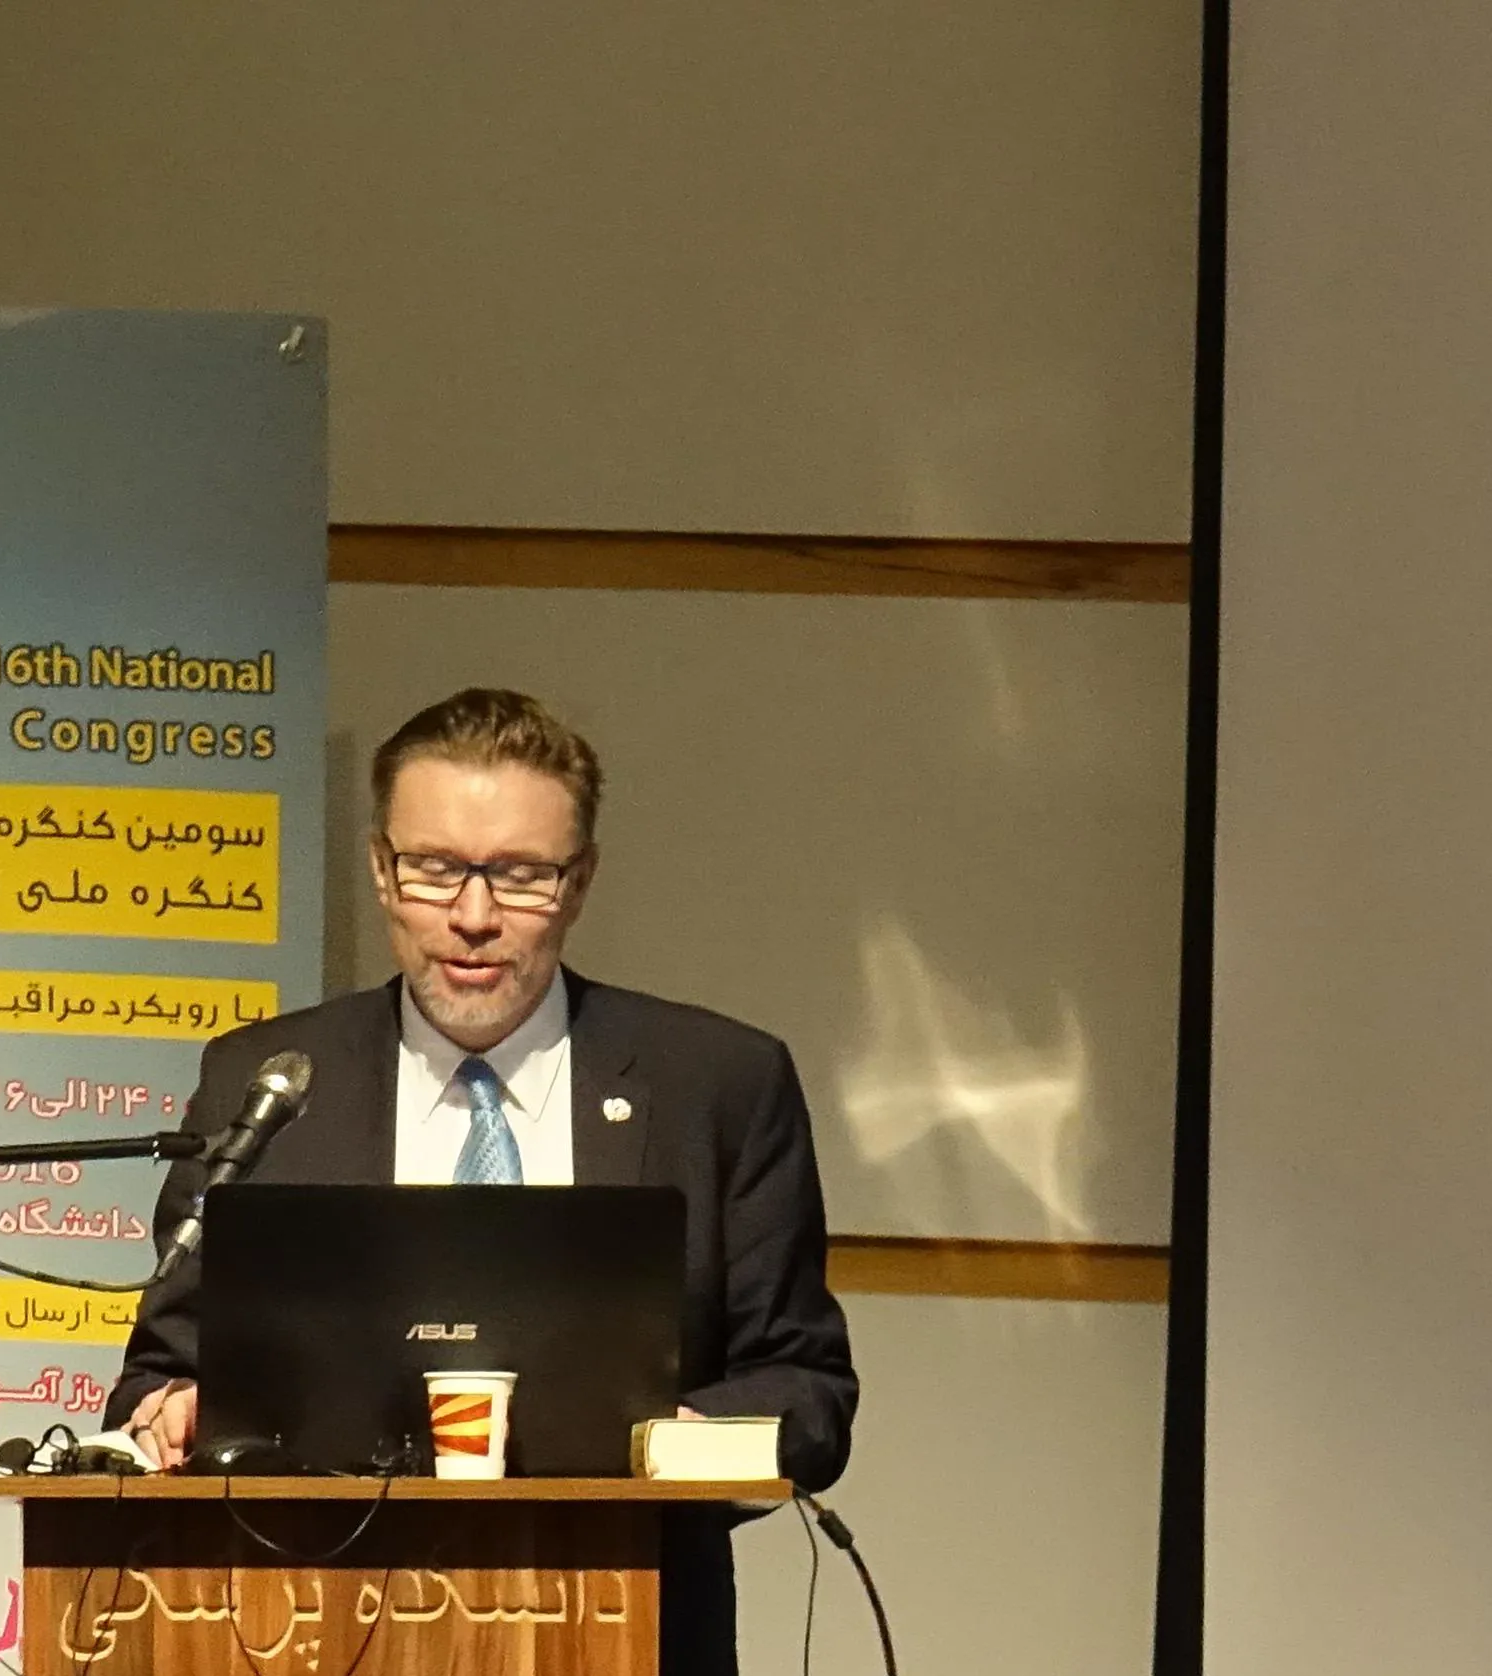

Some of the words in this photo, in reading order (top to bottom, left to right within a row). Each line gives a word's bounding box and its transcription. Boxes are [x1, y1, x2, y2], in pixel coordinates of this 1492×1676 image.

[88, 646, 275, 694] National
[11, 706, 276, 764] Congress
[126, 816, 264, 856] سومین
[17, 868, 108, 912] ملی
[130, 875, 264, 917] کنگره
[102, 993, 219, 1029] رویکرد
[5, 1296, 90, 1332] ارسال
[405, 1322, 479, 1341] ASUS
